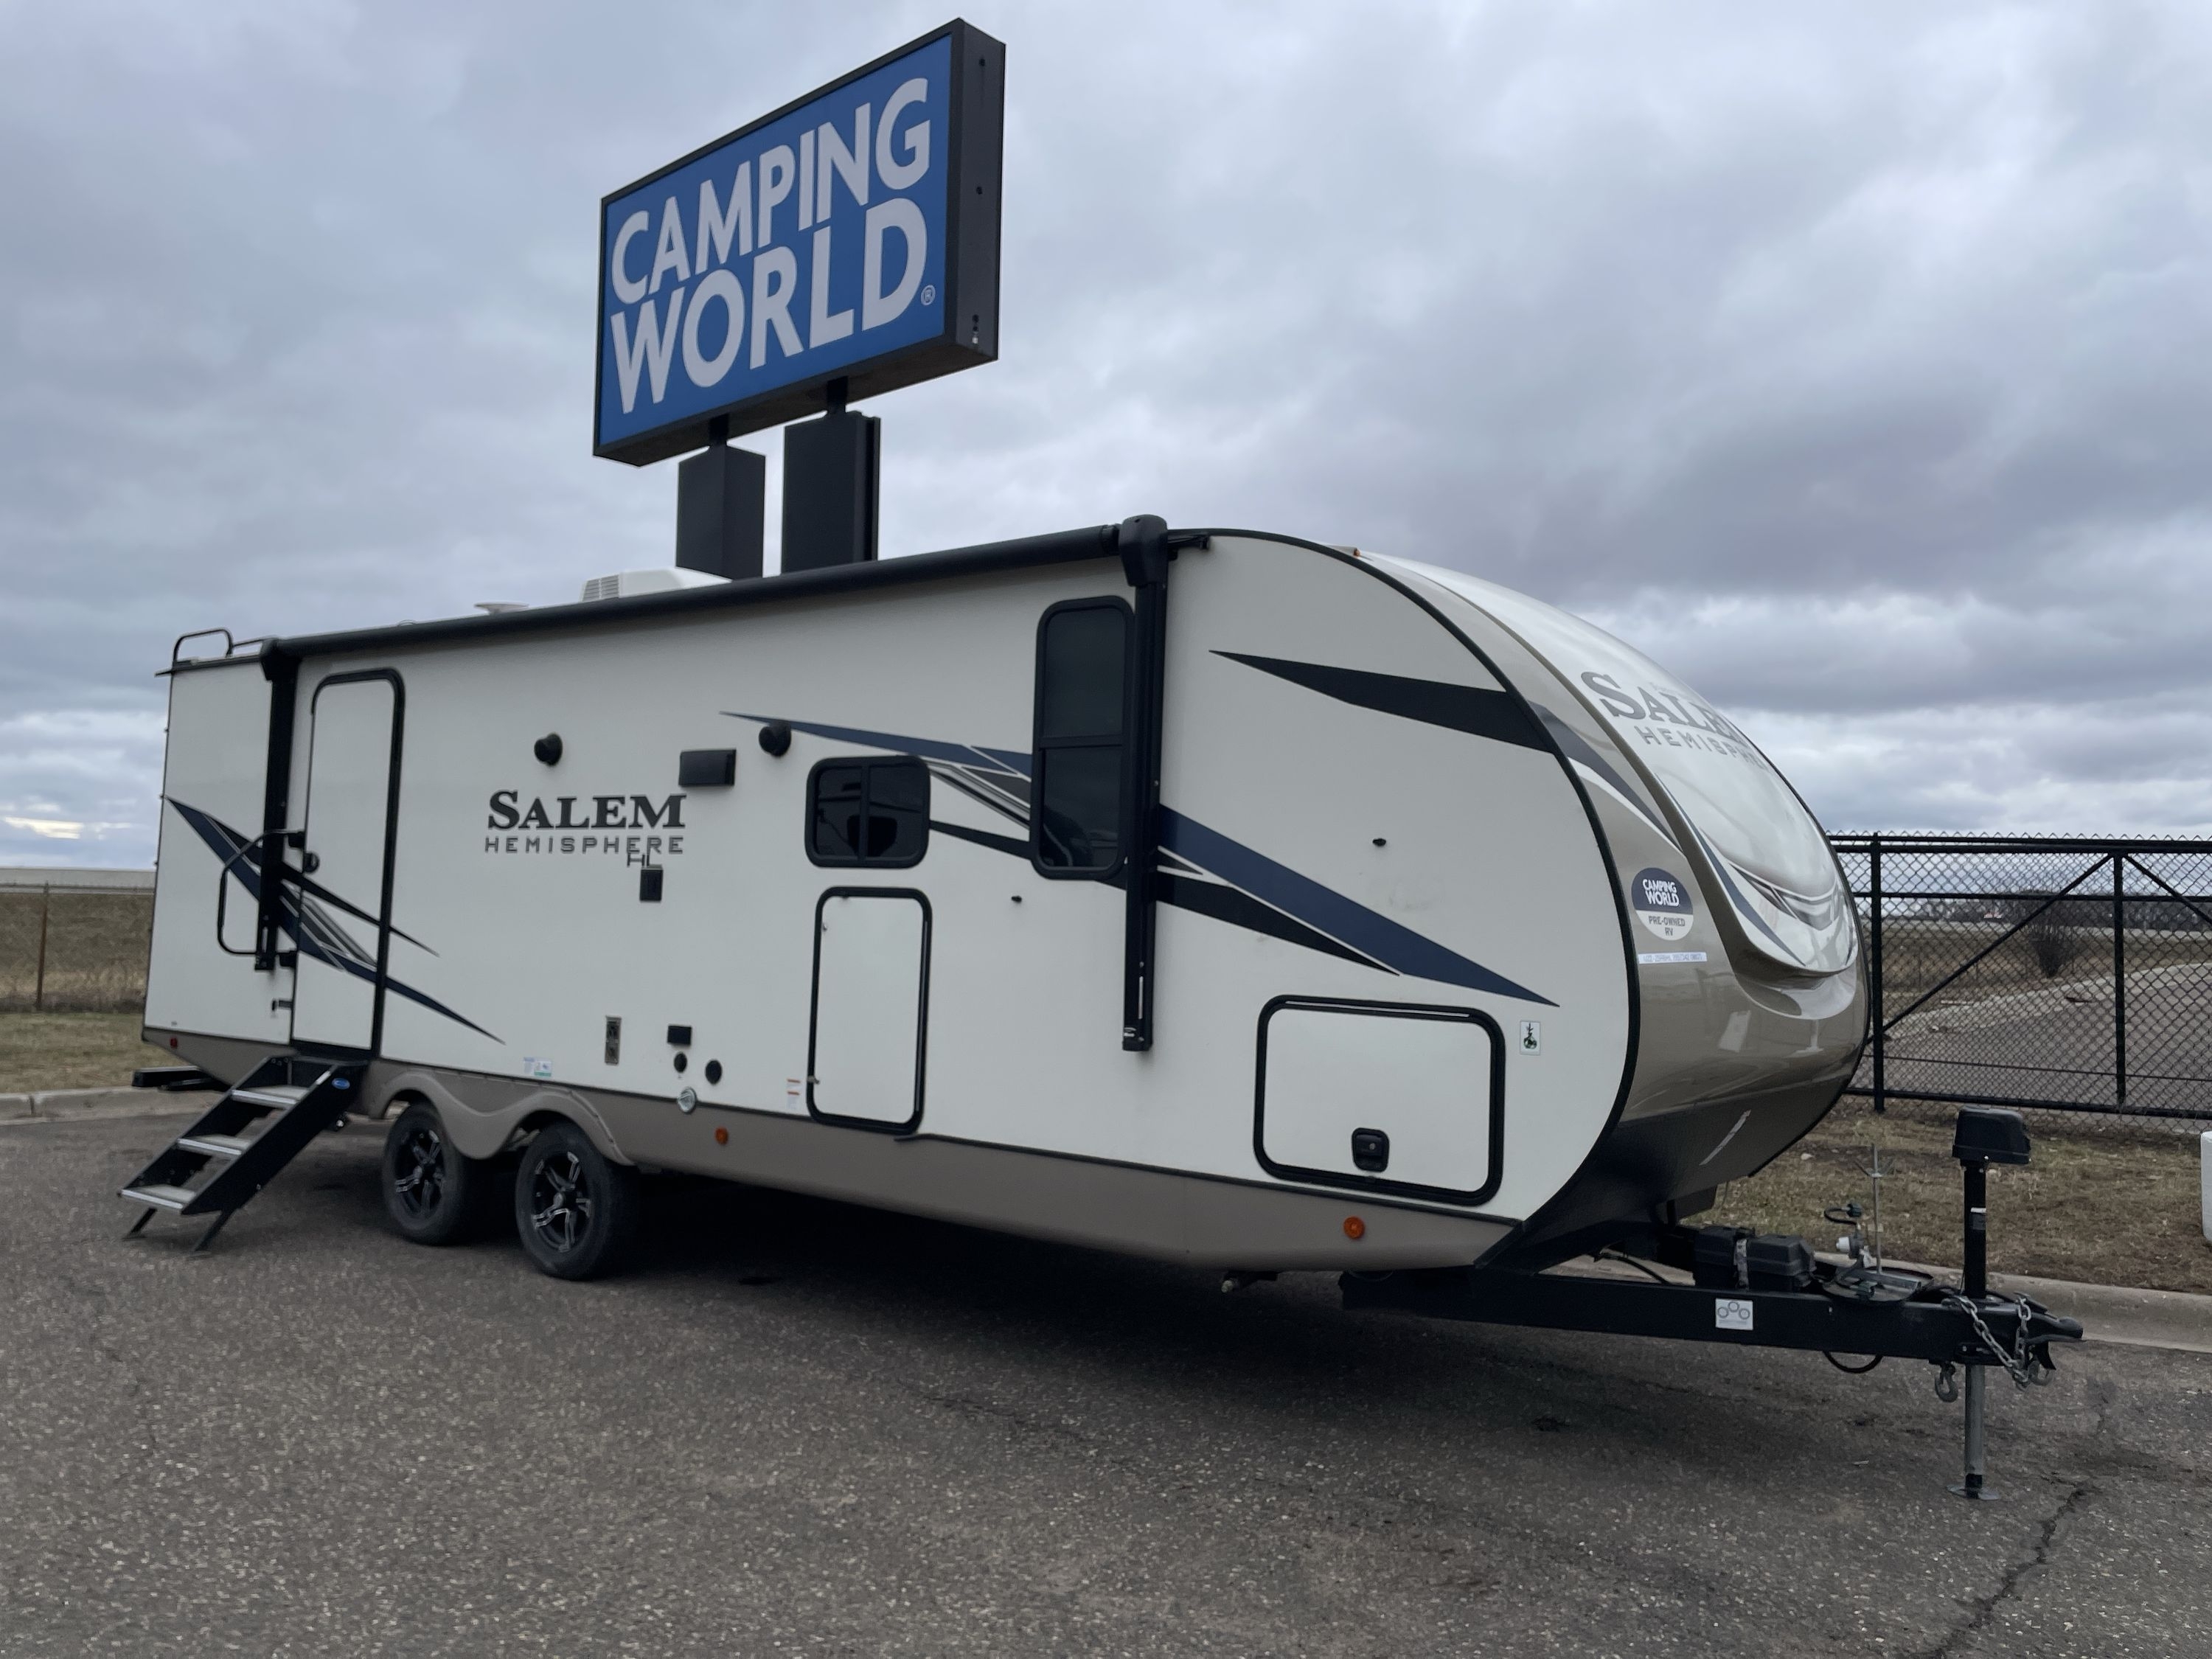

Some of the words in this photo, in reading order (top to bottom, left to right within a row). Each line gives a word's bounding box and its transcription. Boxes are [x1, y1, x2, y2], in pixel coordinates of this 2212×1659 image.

[612, 78, 931, 304] CAMPING
[611, 198, 928, 414] WORLD
[487, 790, 686, 830] SALEM
[485, 836, 684, 854] HEMISPHERE
[1642, 878, 1677, 893] CAMPING
[1645, 891, 1680, 907] WORLD
[1648, 916, 1686, 926] PRE-OWNED
[1664, 928, 1674, 936] RV
